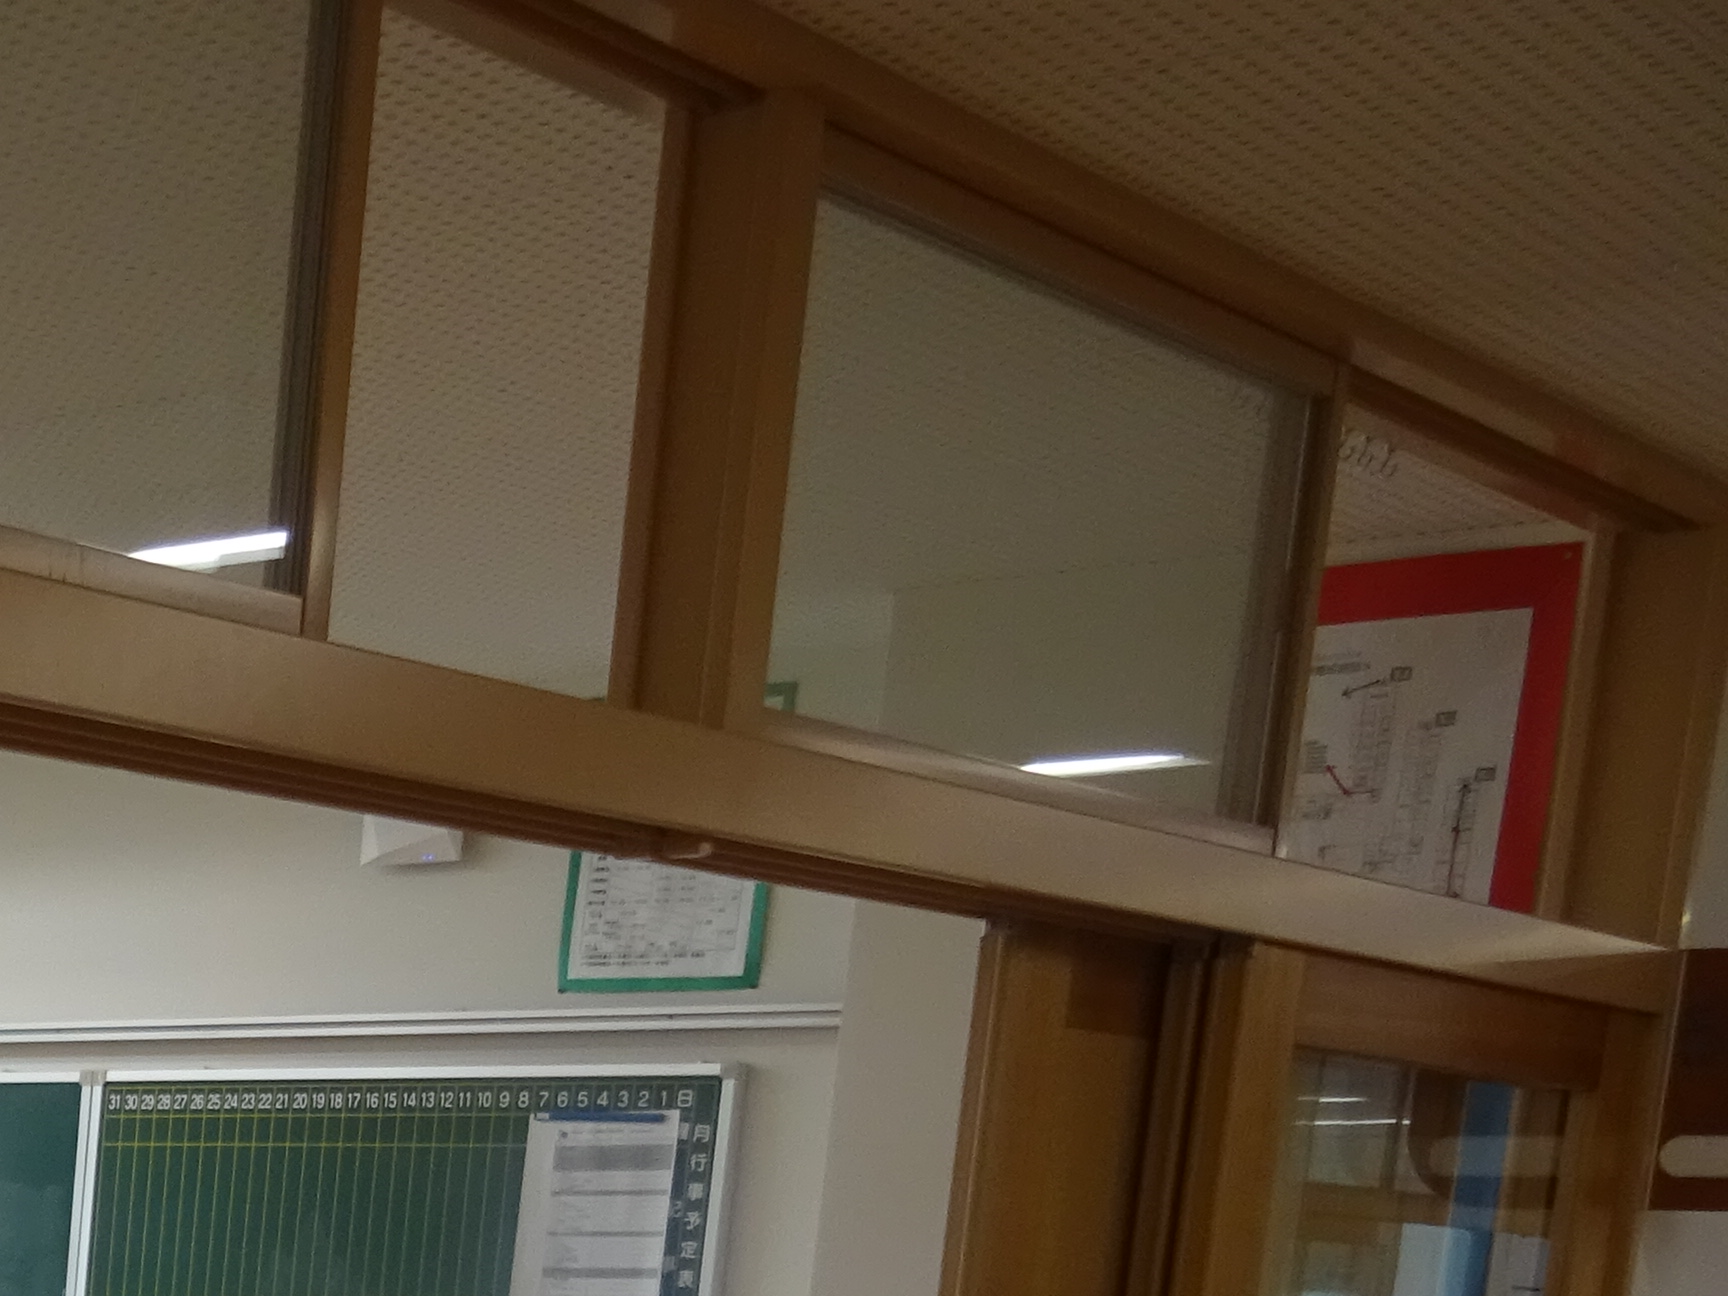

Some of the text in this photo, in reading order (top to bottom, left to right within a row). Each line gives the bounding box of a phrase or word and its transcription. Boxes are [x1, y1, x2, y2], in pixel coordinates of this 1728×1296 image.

[108, 1093, 121, 1110] 31
[124, 1093, 138, 1110] 30
[141, 1093, 154, 1110] 29
[157, 1093, 171, 1110] 28
[174, 1093, 188, 1110] 27
[190, 1093, 204, 1110] 26
[207, 1093, 221, 1110] 25
[224, 1093, 238, 1110] 24
[241, 1093, 255, 1110] 23
[258, 1093, 272, 1110] 22
[275, 1093, 289, 1110] 21
[293, 1093, 307, 1110] 20
[312, 1092, 325, 1109] 19
[329, 1092, 342, 1109] 18
[348, 1092, 361, 1109] 17
[366, 1092, 379, 1109] 16
[384, 1092, 397, 1109] 15
[402, 1092, 417, 1109] 14
[421, 1091, 434, 1108] 13
[440, 1091, 453, 1108] 12
[458, 1091, 471, 1108] 11
[478, 1091, 492, 1108] 10
[498, 1091, 510, 1108] 9
[517, 1091, 529, 1108] 8
[539, 1091, 549, 1108] 7
[556, 1091, 568, 1108] 6
[577, 1091, 589, 1108] 5
[596, 1091, 609, 1108] 4
[617, 1091, 629, 1108] 3
[637, 1091, 650, 1108] 2
[677, 1089, 693, 1108] 日
